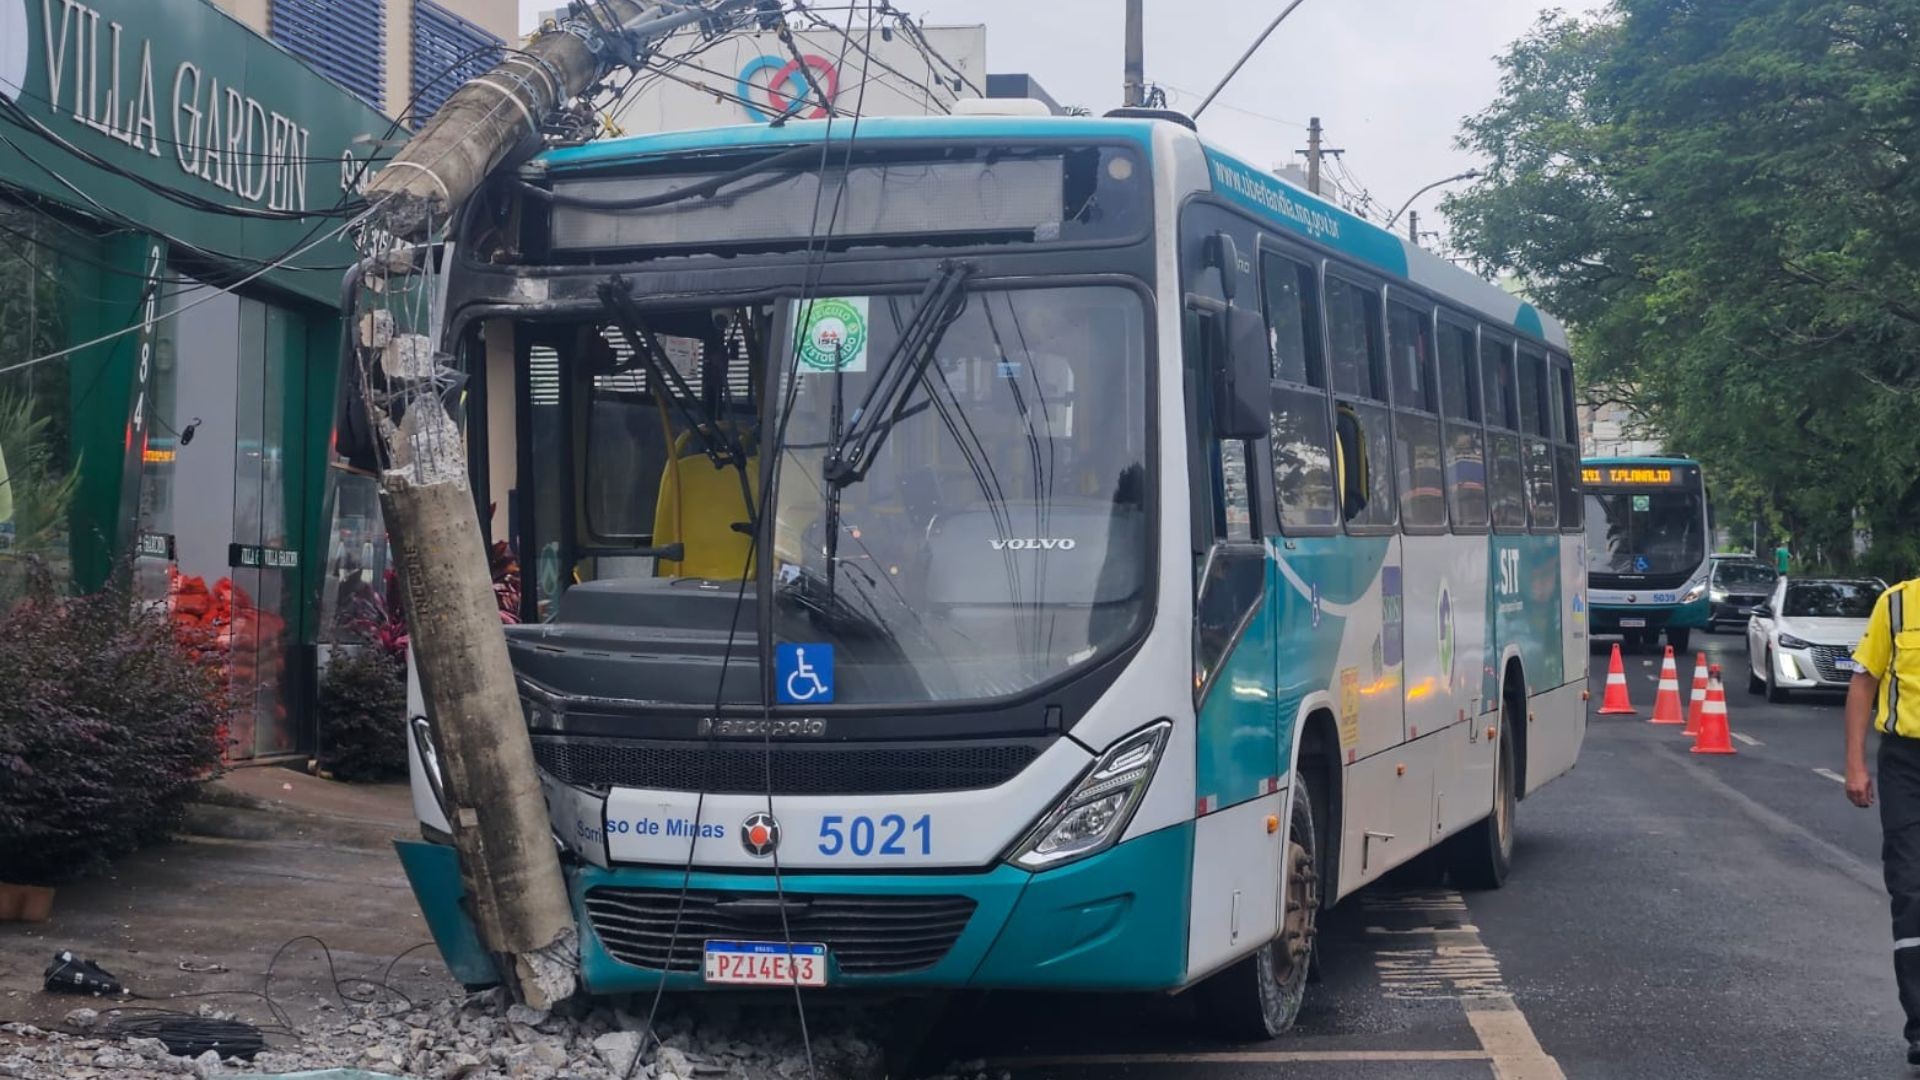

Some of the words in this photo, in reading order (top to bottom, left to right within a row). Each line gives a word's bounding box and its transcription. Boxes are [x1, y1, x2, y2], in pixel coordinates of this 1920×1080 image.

[42, 0, 160, 157] VILLA
[173, 62, 309, 223] GARDEN
[988, 538, 1076, 550] VOLVO
[1501, 548, 1519, 595] SIT
[703, 717, 823, 736] Marcopolo
[636, 817, 659, 836] de
[666, 818, 725, 839] Minas
[818, 814, 932, 857] 5021
